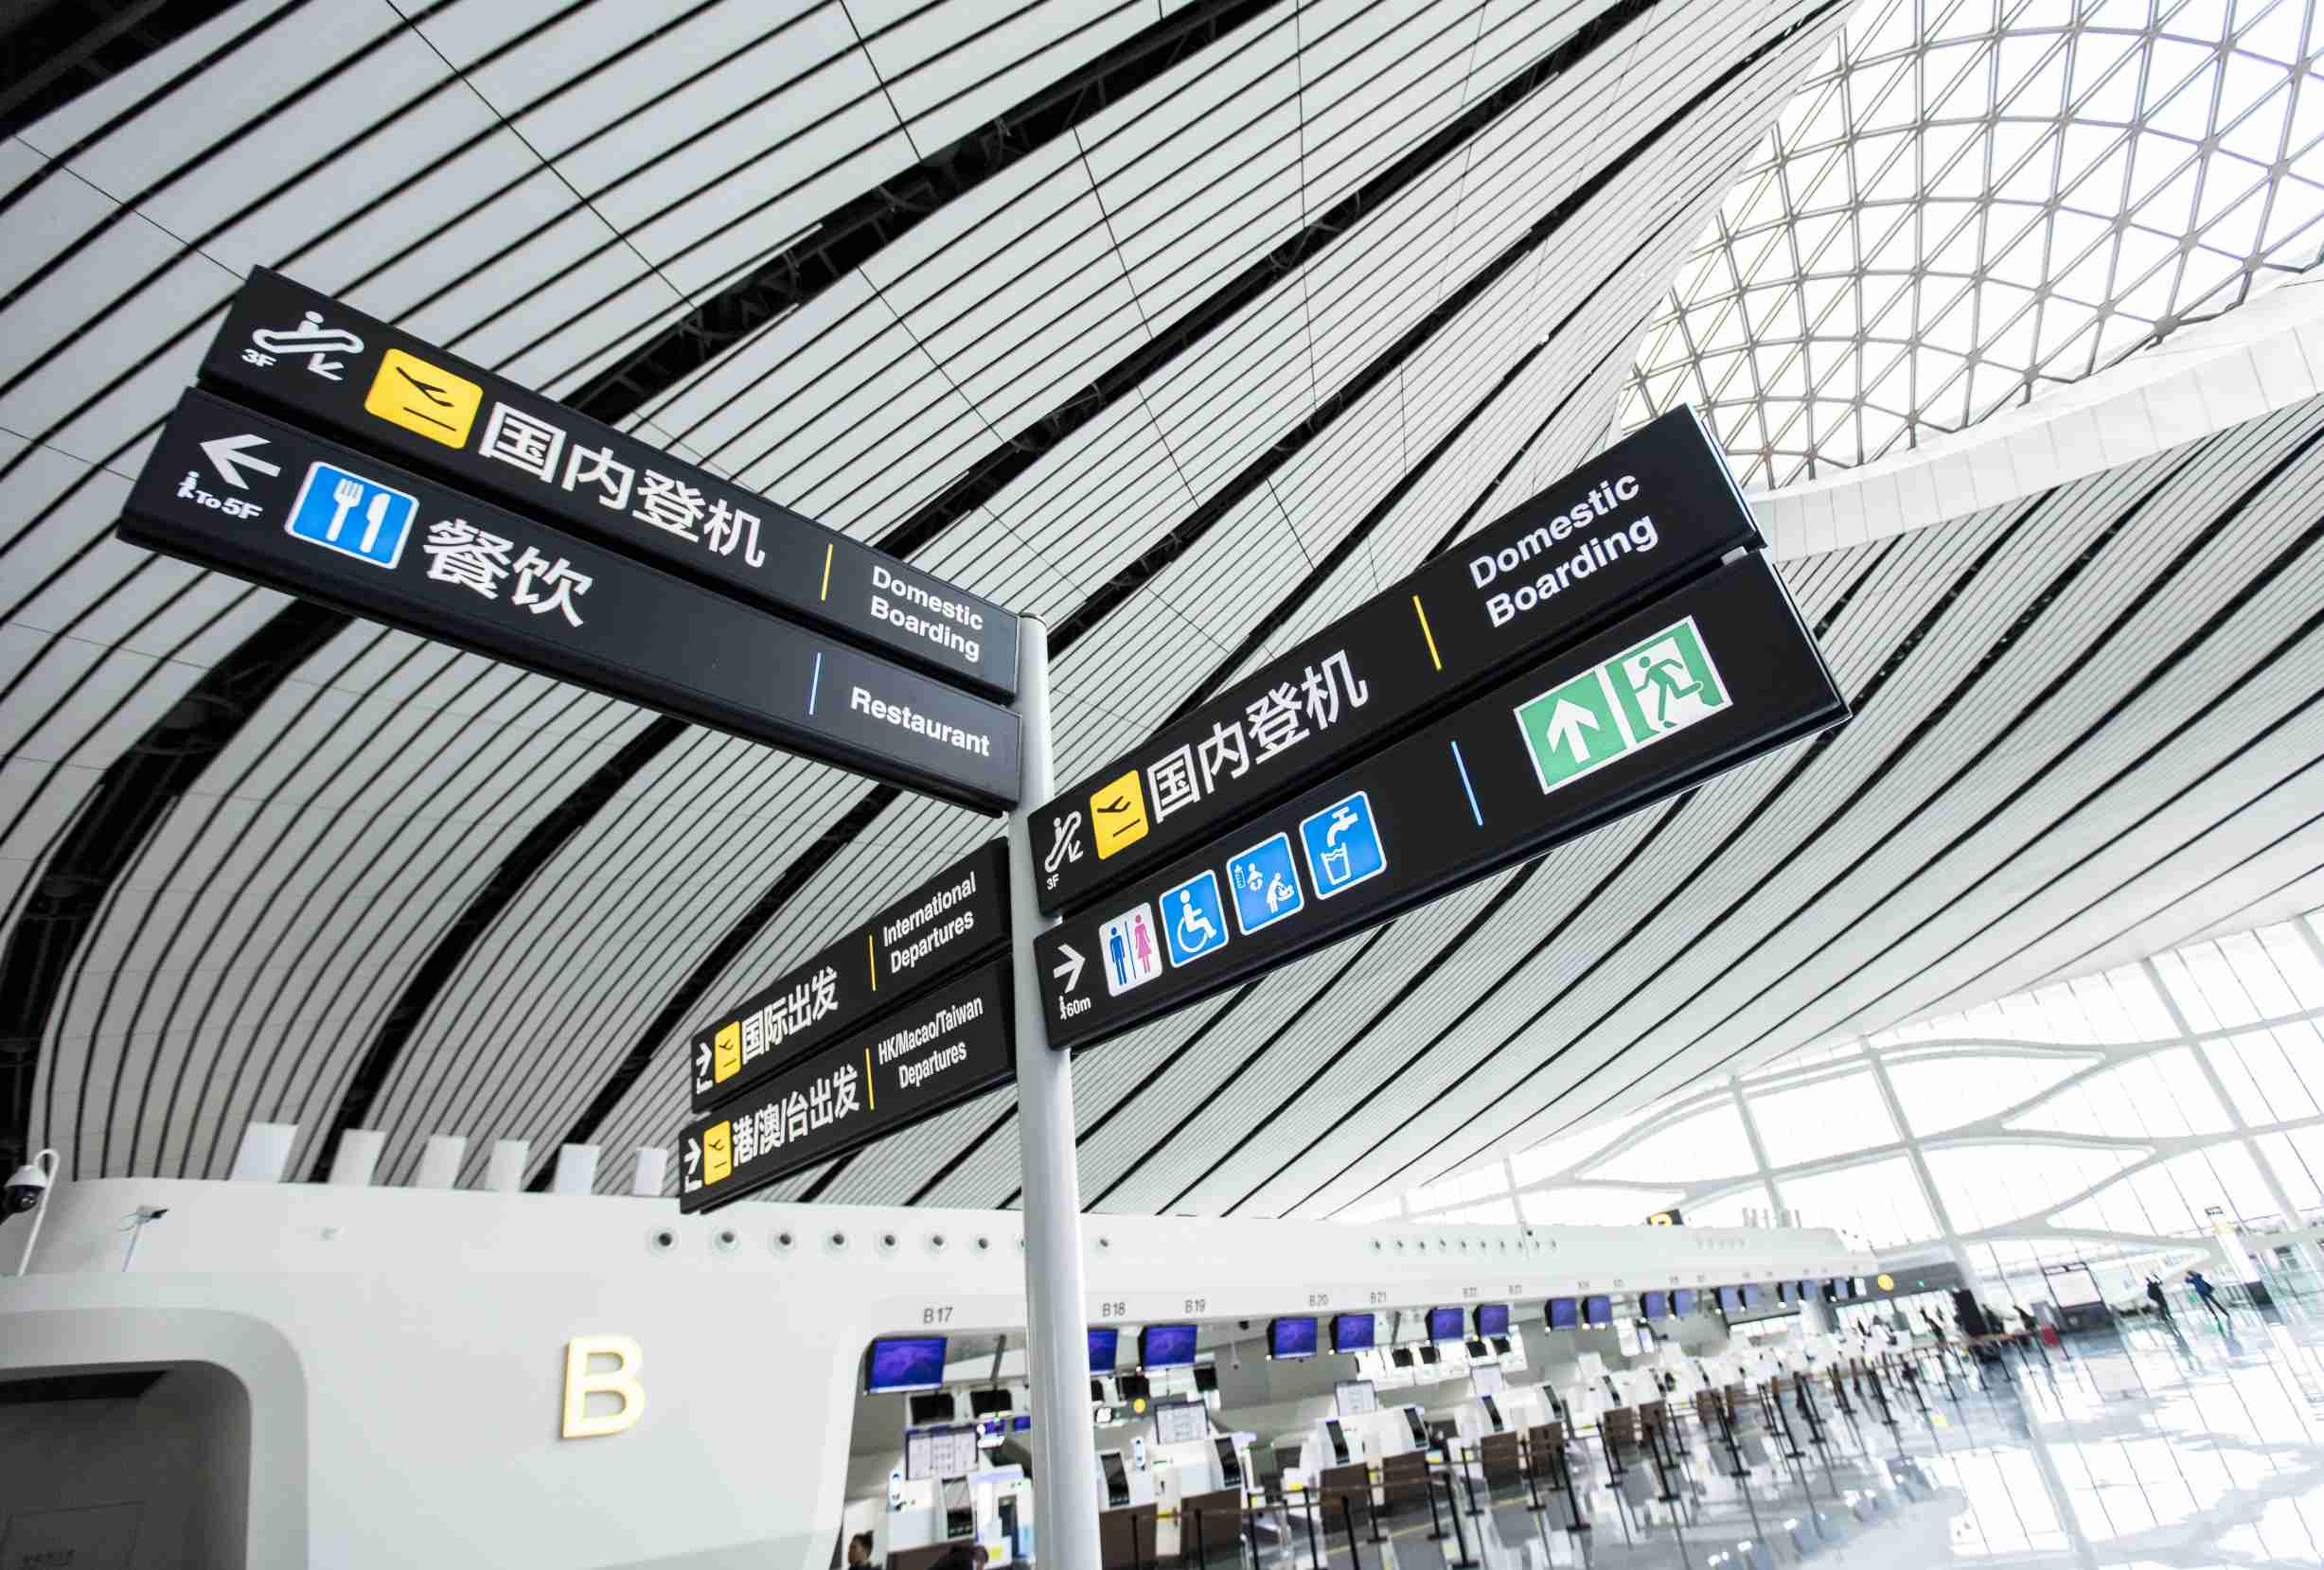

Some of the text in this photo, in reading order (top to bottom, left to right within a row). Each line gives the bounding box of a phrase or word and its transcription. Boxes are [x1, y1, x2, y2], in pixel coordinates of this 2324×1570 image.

[242, 348, 276, 367] 3F
[477, 401, 766, 569] 国内登机
[1469, 475, 1640, 590] Domestic
[422, 519, 594, 627] 餐饮
[872, 565, 985, 631] Domestic
[1485, 516, 1659, 628] Boarding
[870, 595, 981, 663] Boarding
[850, 686, 990, 757] Restaurant
[1146, 649, 1369, 824] 国内登机
[883, 871, 977, 947] International
[1046, 873, 1059, 891] 3F
[890, 910, 974, 974] Departures
[741, 965, 839, 1066] 国际出发
[878, 997, 984, 1066] HK/Macao/Taiwan
[1067, 997, 1091, 1017] 60m
[898, 1041, 967, 1089] Departures
[923, 1306, 954, 1325] B17
[1101, 1301, 1127, 1318] B18
[560, 1335, 647, 1438] B
